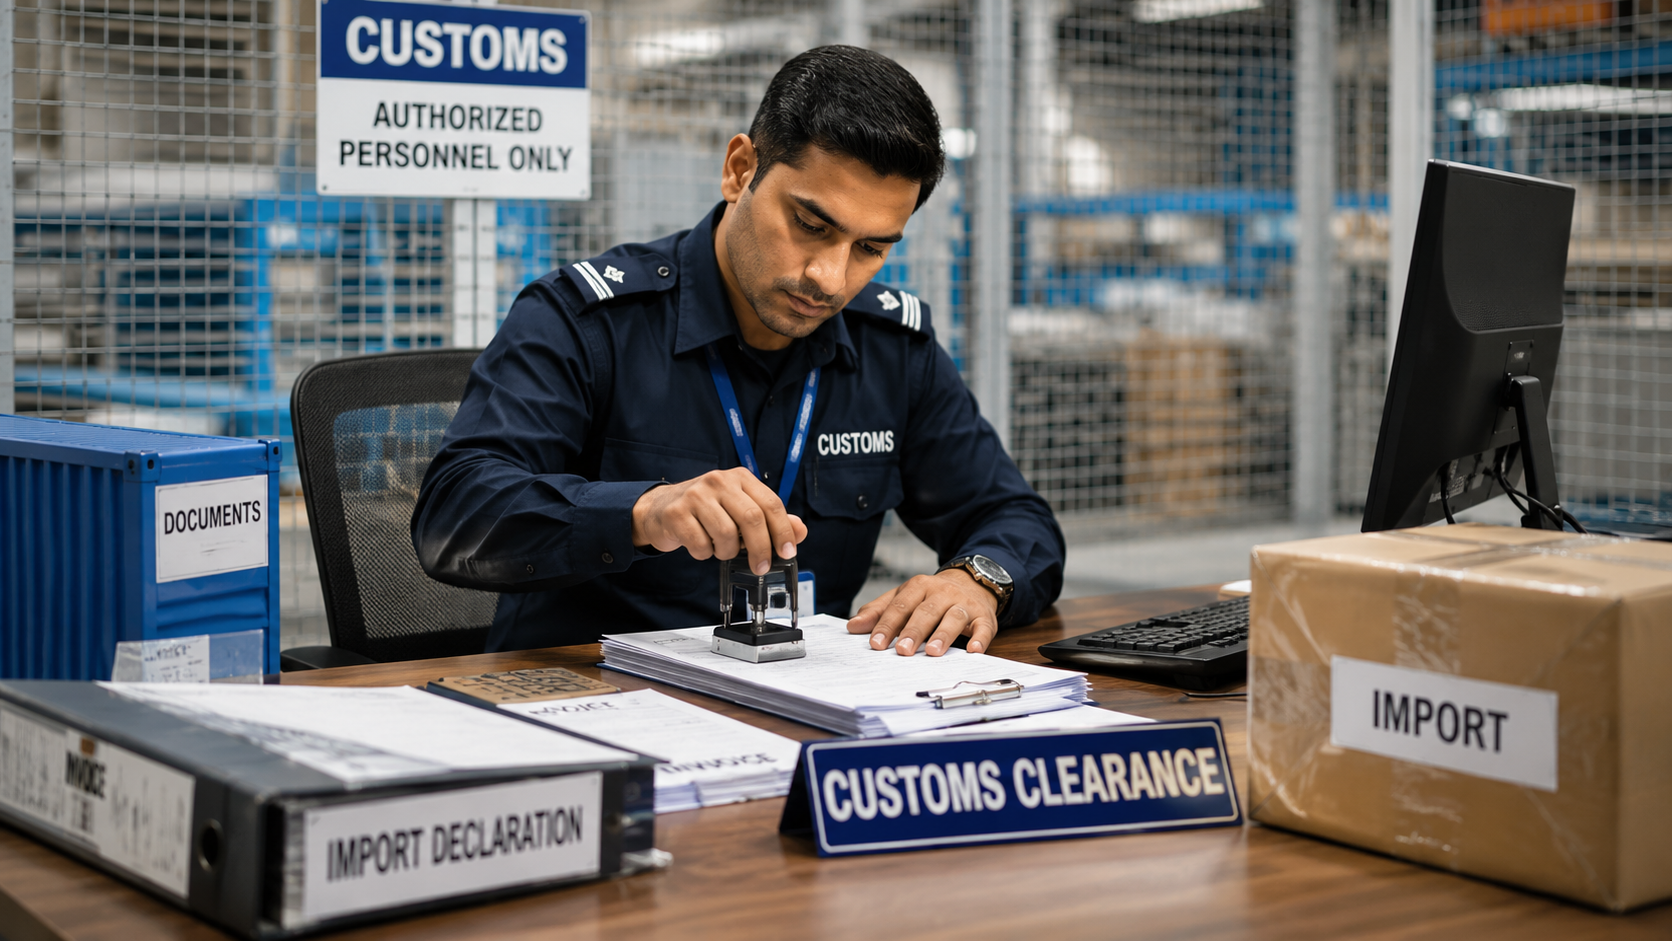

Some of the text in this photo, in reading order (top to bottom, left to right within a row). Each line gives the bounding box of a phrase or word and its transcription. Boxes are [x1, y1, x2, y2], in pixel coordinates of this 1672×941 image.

[346, 16, 568, 75] CUSTOMS
[373, 101, 543, 132] AUTHORIZED
[340, 140, 572, 172] PERSONNEL ONLY
[818, 430, 895, 456] CUSTOMS
[164, 500, 261, 535] DOCUMENTS
[1373, 689, 1509, 754] IMPORT
[823, 747, 1225, 822] CUSTOMS CLEARANCE
[327, 805, 584, 882] IMPORT DECLARATION
